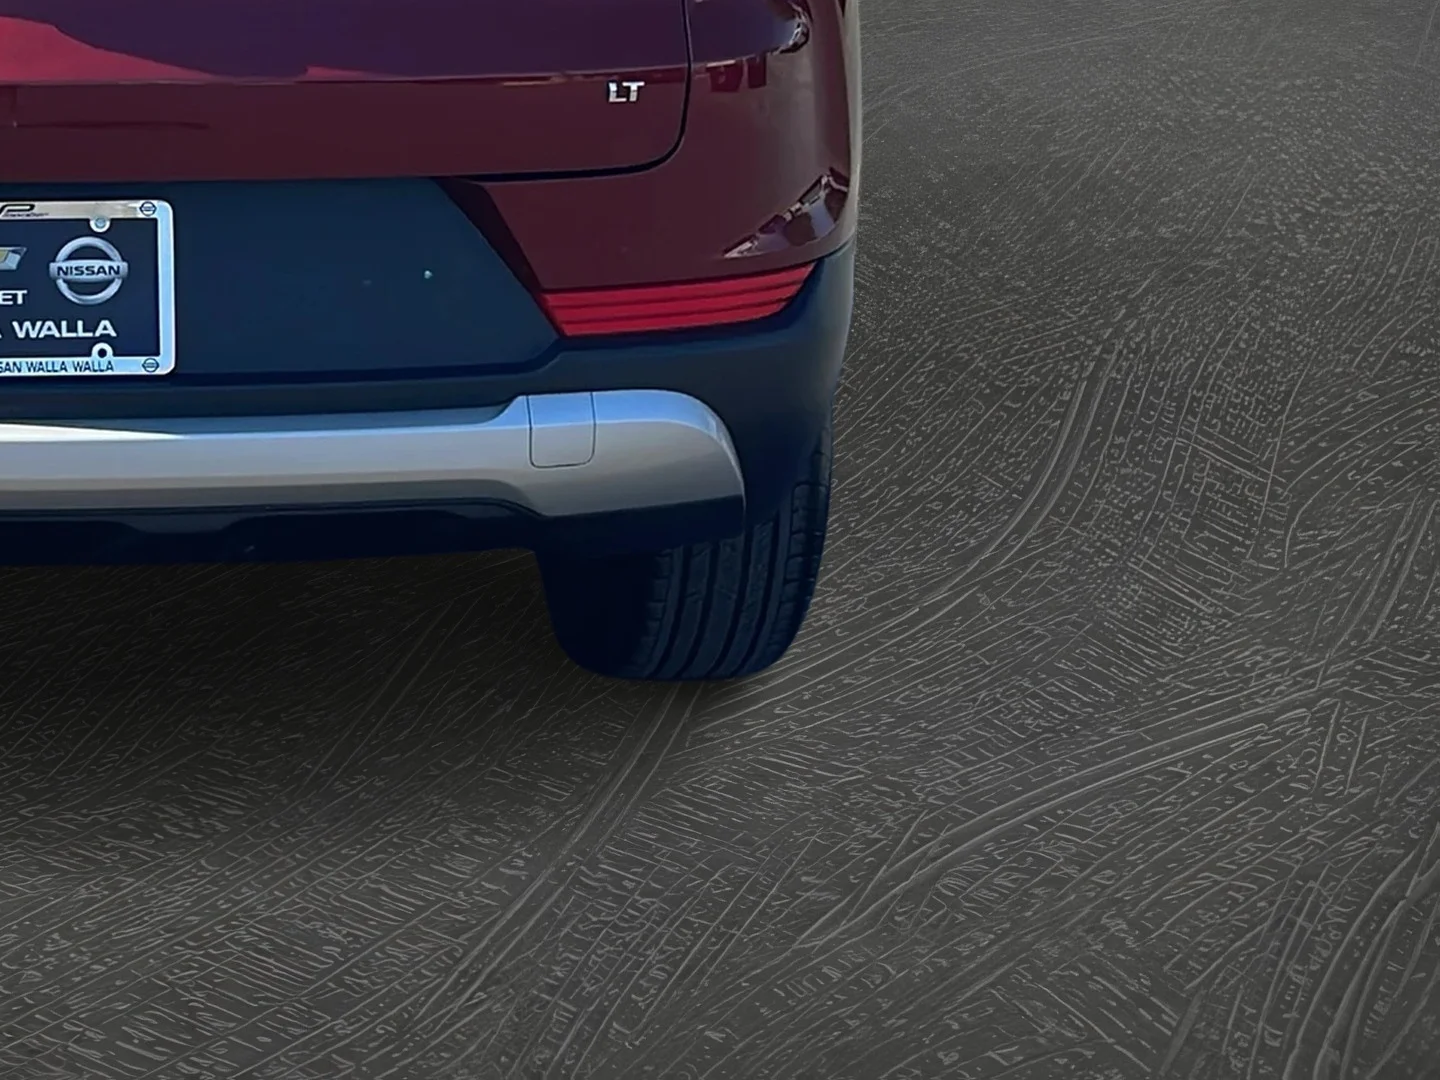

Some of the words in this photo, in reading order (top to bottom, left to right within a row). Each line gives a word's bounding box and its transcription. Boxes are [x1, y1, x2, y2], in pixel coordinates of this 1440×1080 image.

[608, 81, 645, 102] LT
[56, 264, 121, 277] NISSAN
[12, 319, 117, 338] WALLA
[26, 360, 68, 373] WALLA
[73, 359, 115, 372] WALLA
